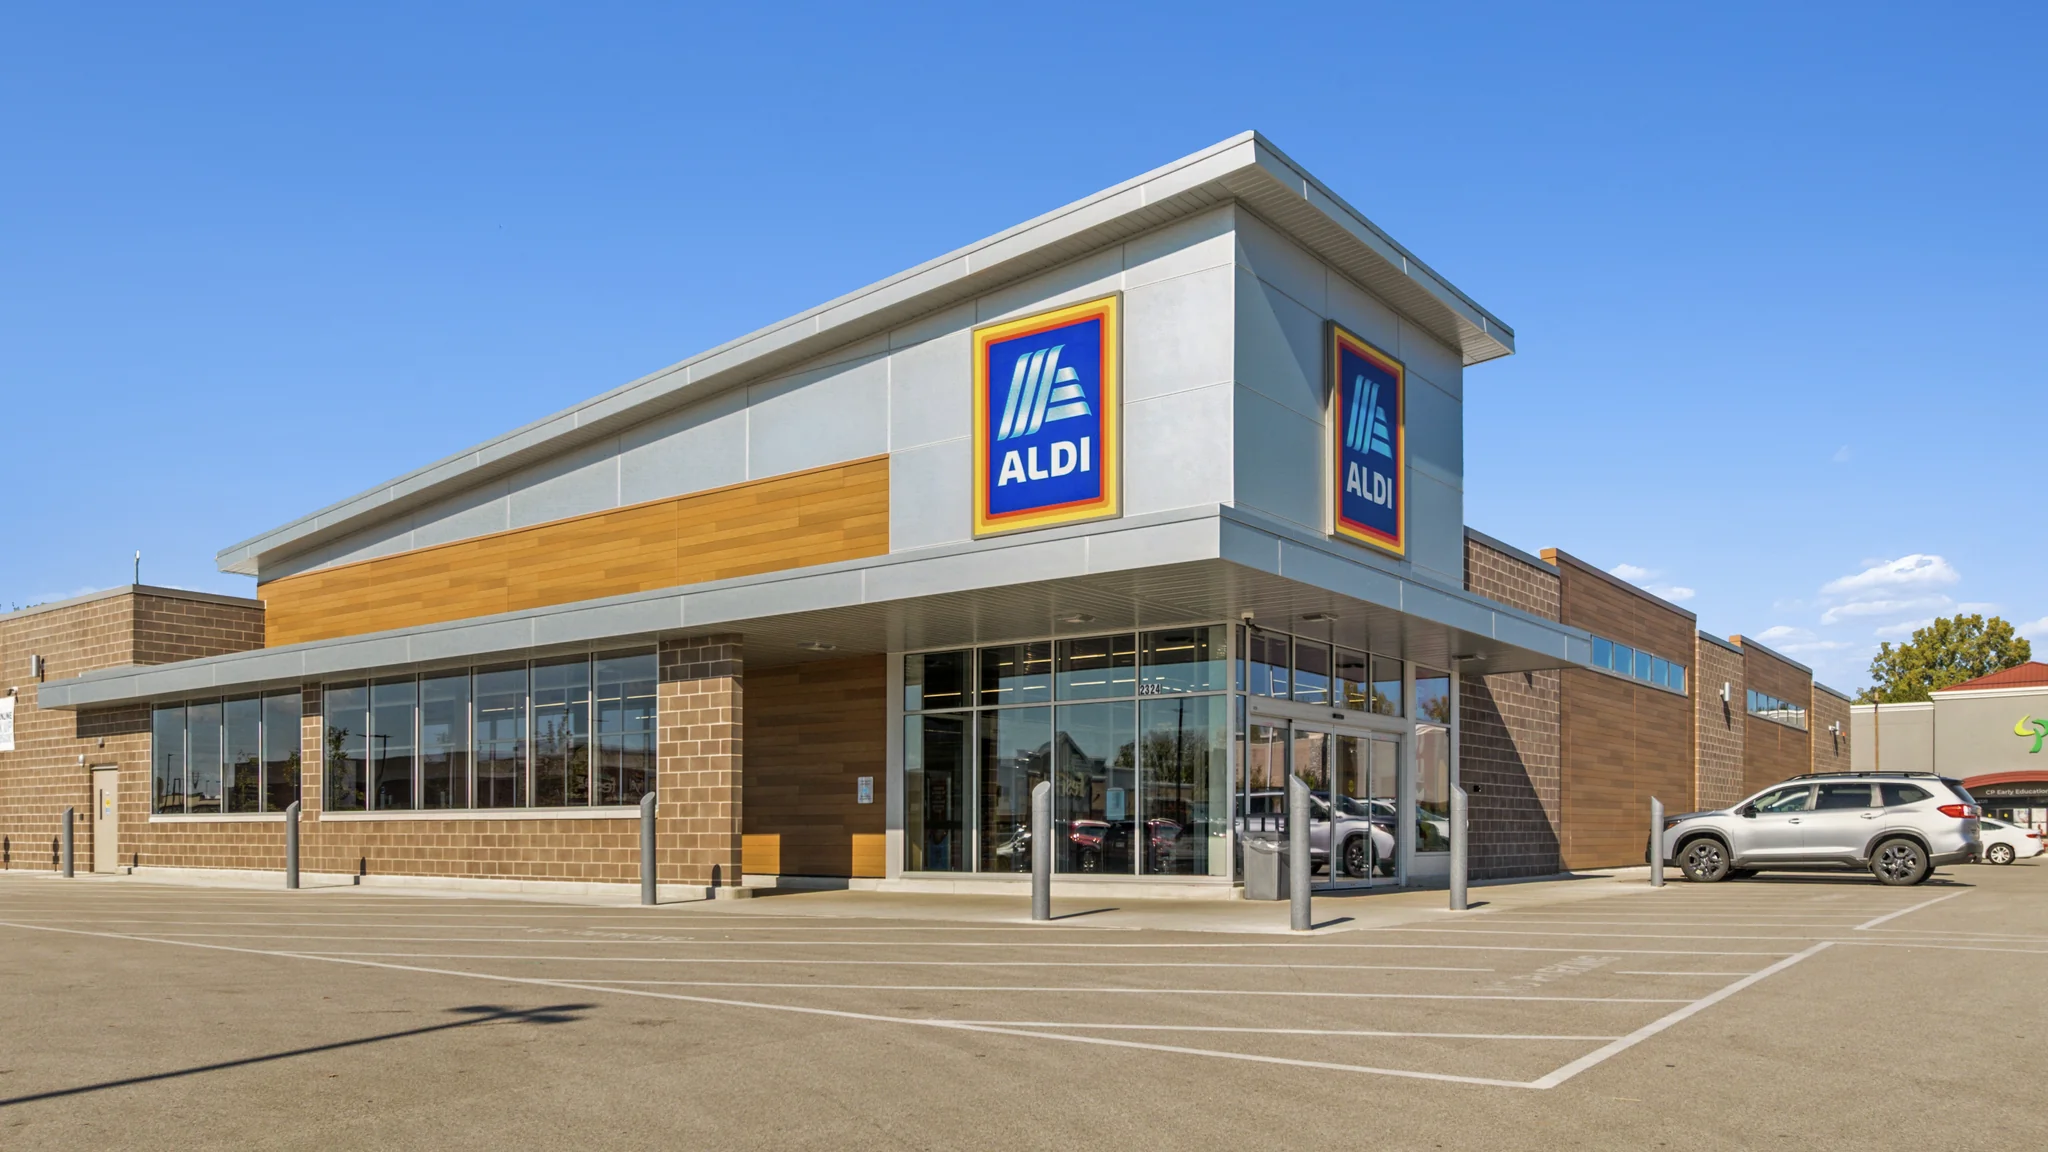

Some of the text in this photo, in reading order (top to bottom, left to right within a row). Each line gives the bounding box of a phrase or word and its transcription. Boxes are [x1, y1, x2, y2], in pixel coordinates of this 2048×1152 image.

[998, 436, 1090, 487] ALDI
[1346, 460, 1393, 510] ALDI
[1140, 684, 1160, 695] 2324
